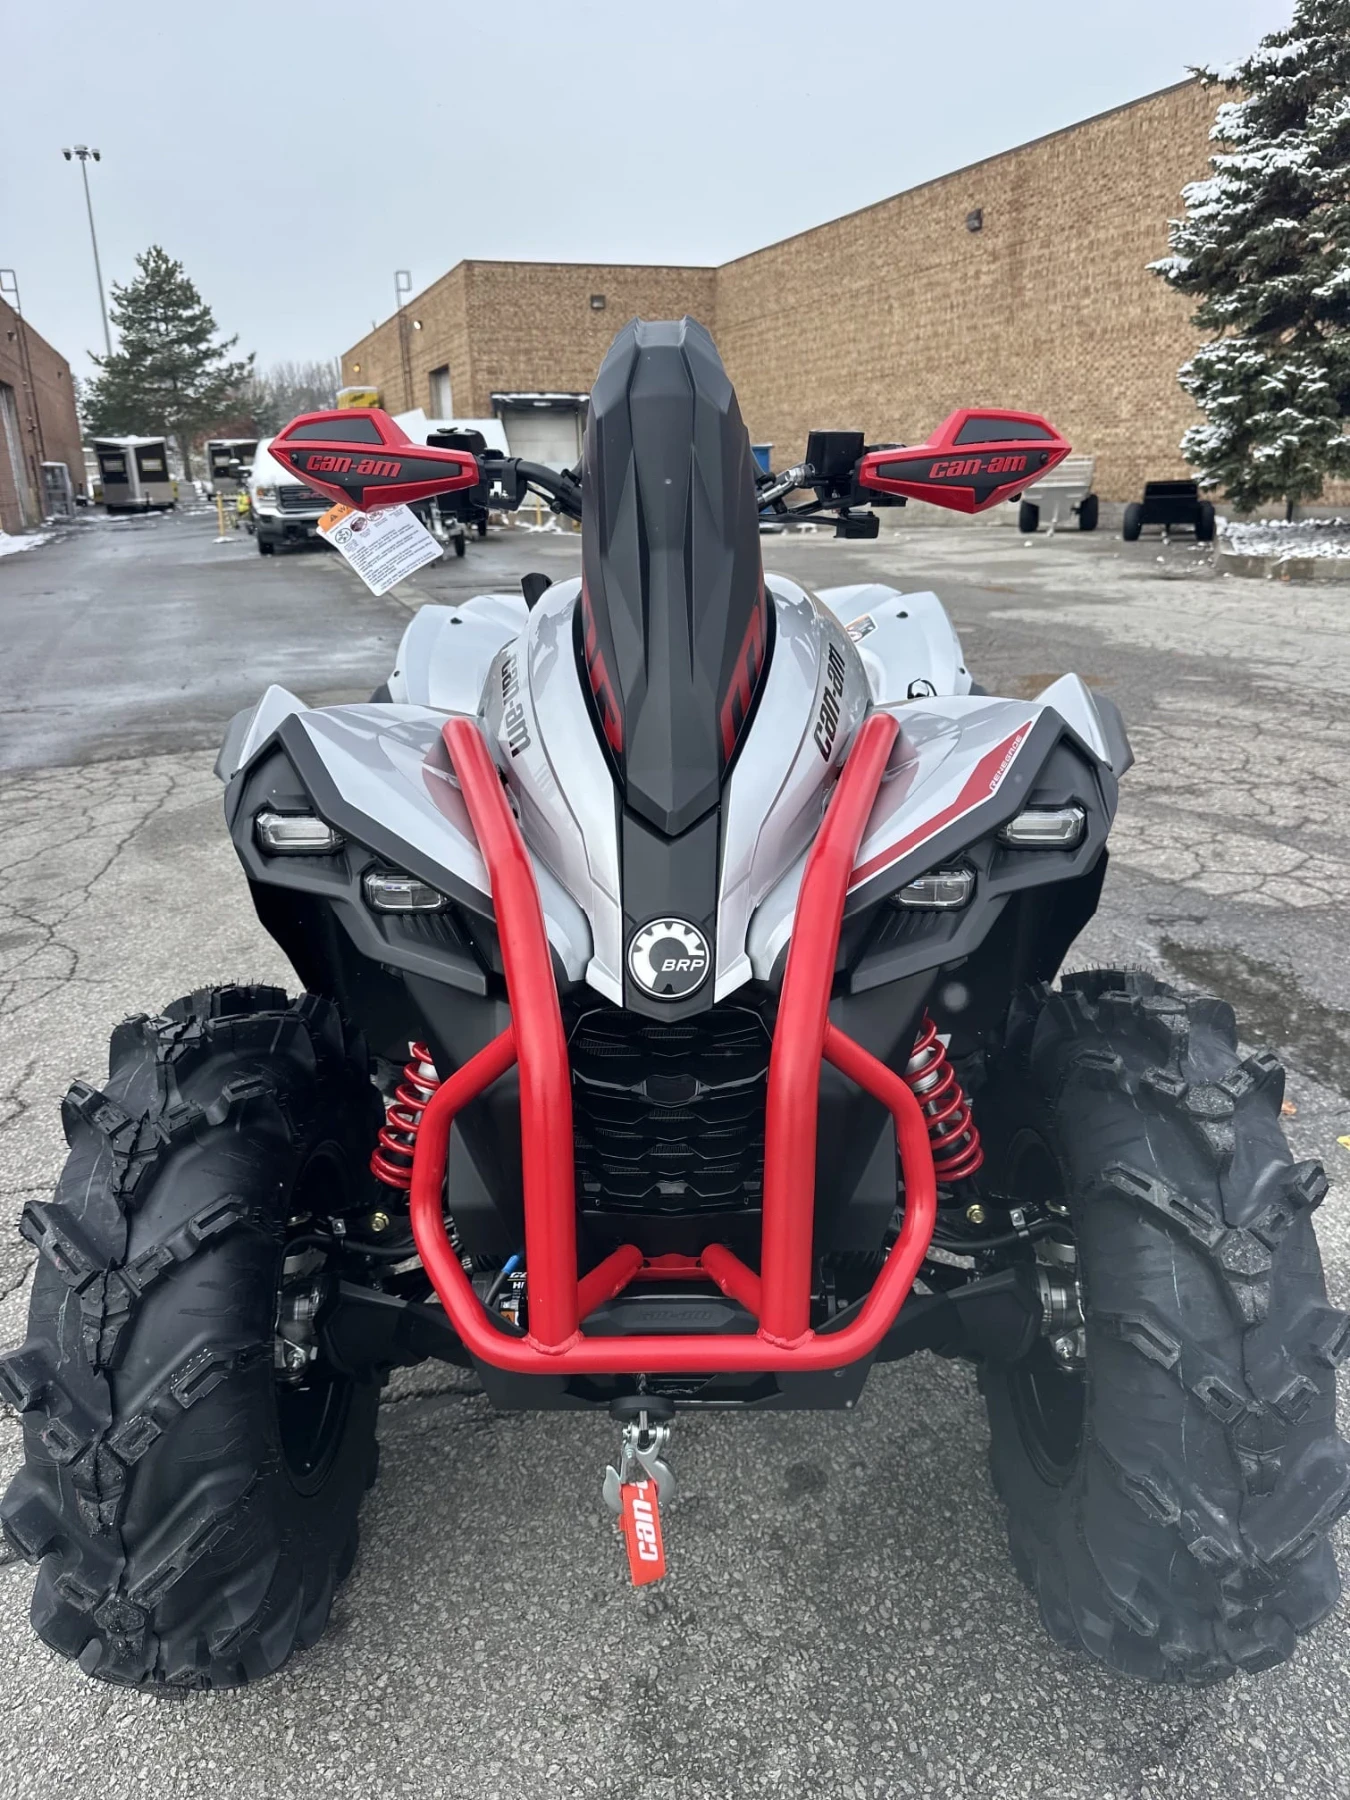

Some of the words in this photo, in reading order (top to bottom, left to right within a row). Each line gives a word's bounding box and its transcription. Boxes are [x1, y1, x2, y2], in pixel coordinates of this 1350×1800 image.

[306, 455, 402, 478] can-am
[929, 455, 1027, 479] can-am
[501, 653, 531, 758] can-am
[813, 642, 845, 762] can-am
[989, 734, 1022, 792] RENEGADE
[661, 959, 705, 972] BRP
